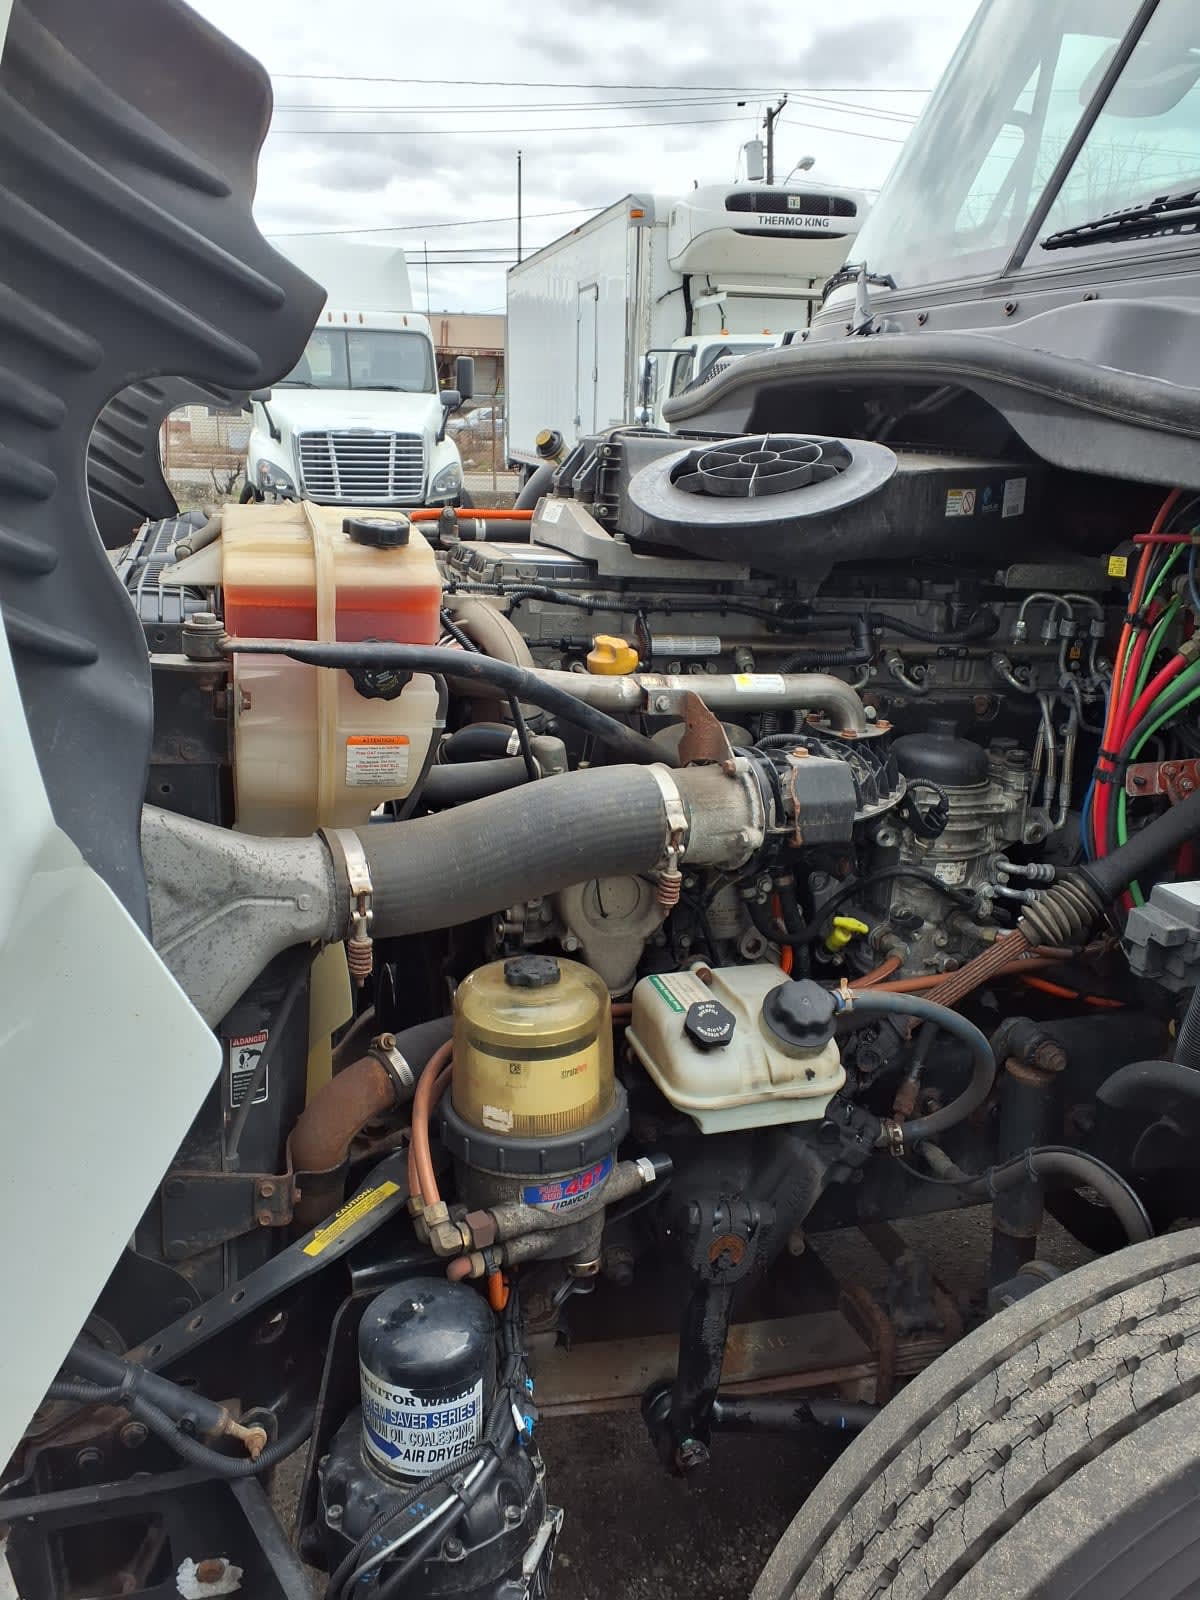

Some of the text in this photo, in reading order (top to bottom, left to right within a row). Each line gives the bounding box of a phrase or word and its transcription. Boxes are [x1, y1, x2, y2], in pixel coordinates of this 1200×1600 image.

[758, 215, 830, 228] THERMO KING
[240, 1033, 266, 1045] DANGER
[560, 1191, 590, 1208] DAVCO
[360, 1368, 417, 1407] ERITOR
[390, 1410, 428, 1429] SAVER
[431, 1401, 474, 1428] SERIES
[390, 1426, 407, 1446] OIL
[409, 1419, 475, 1447] COALESCING
[402, 1436, 476, 1463] AIR DRYERS
